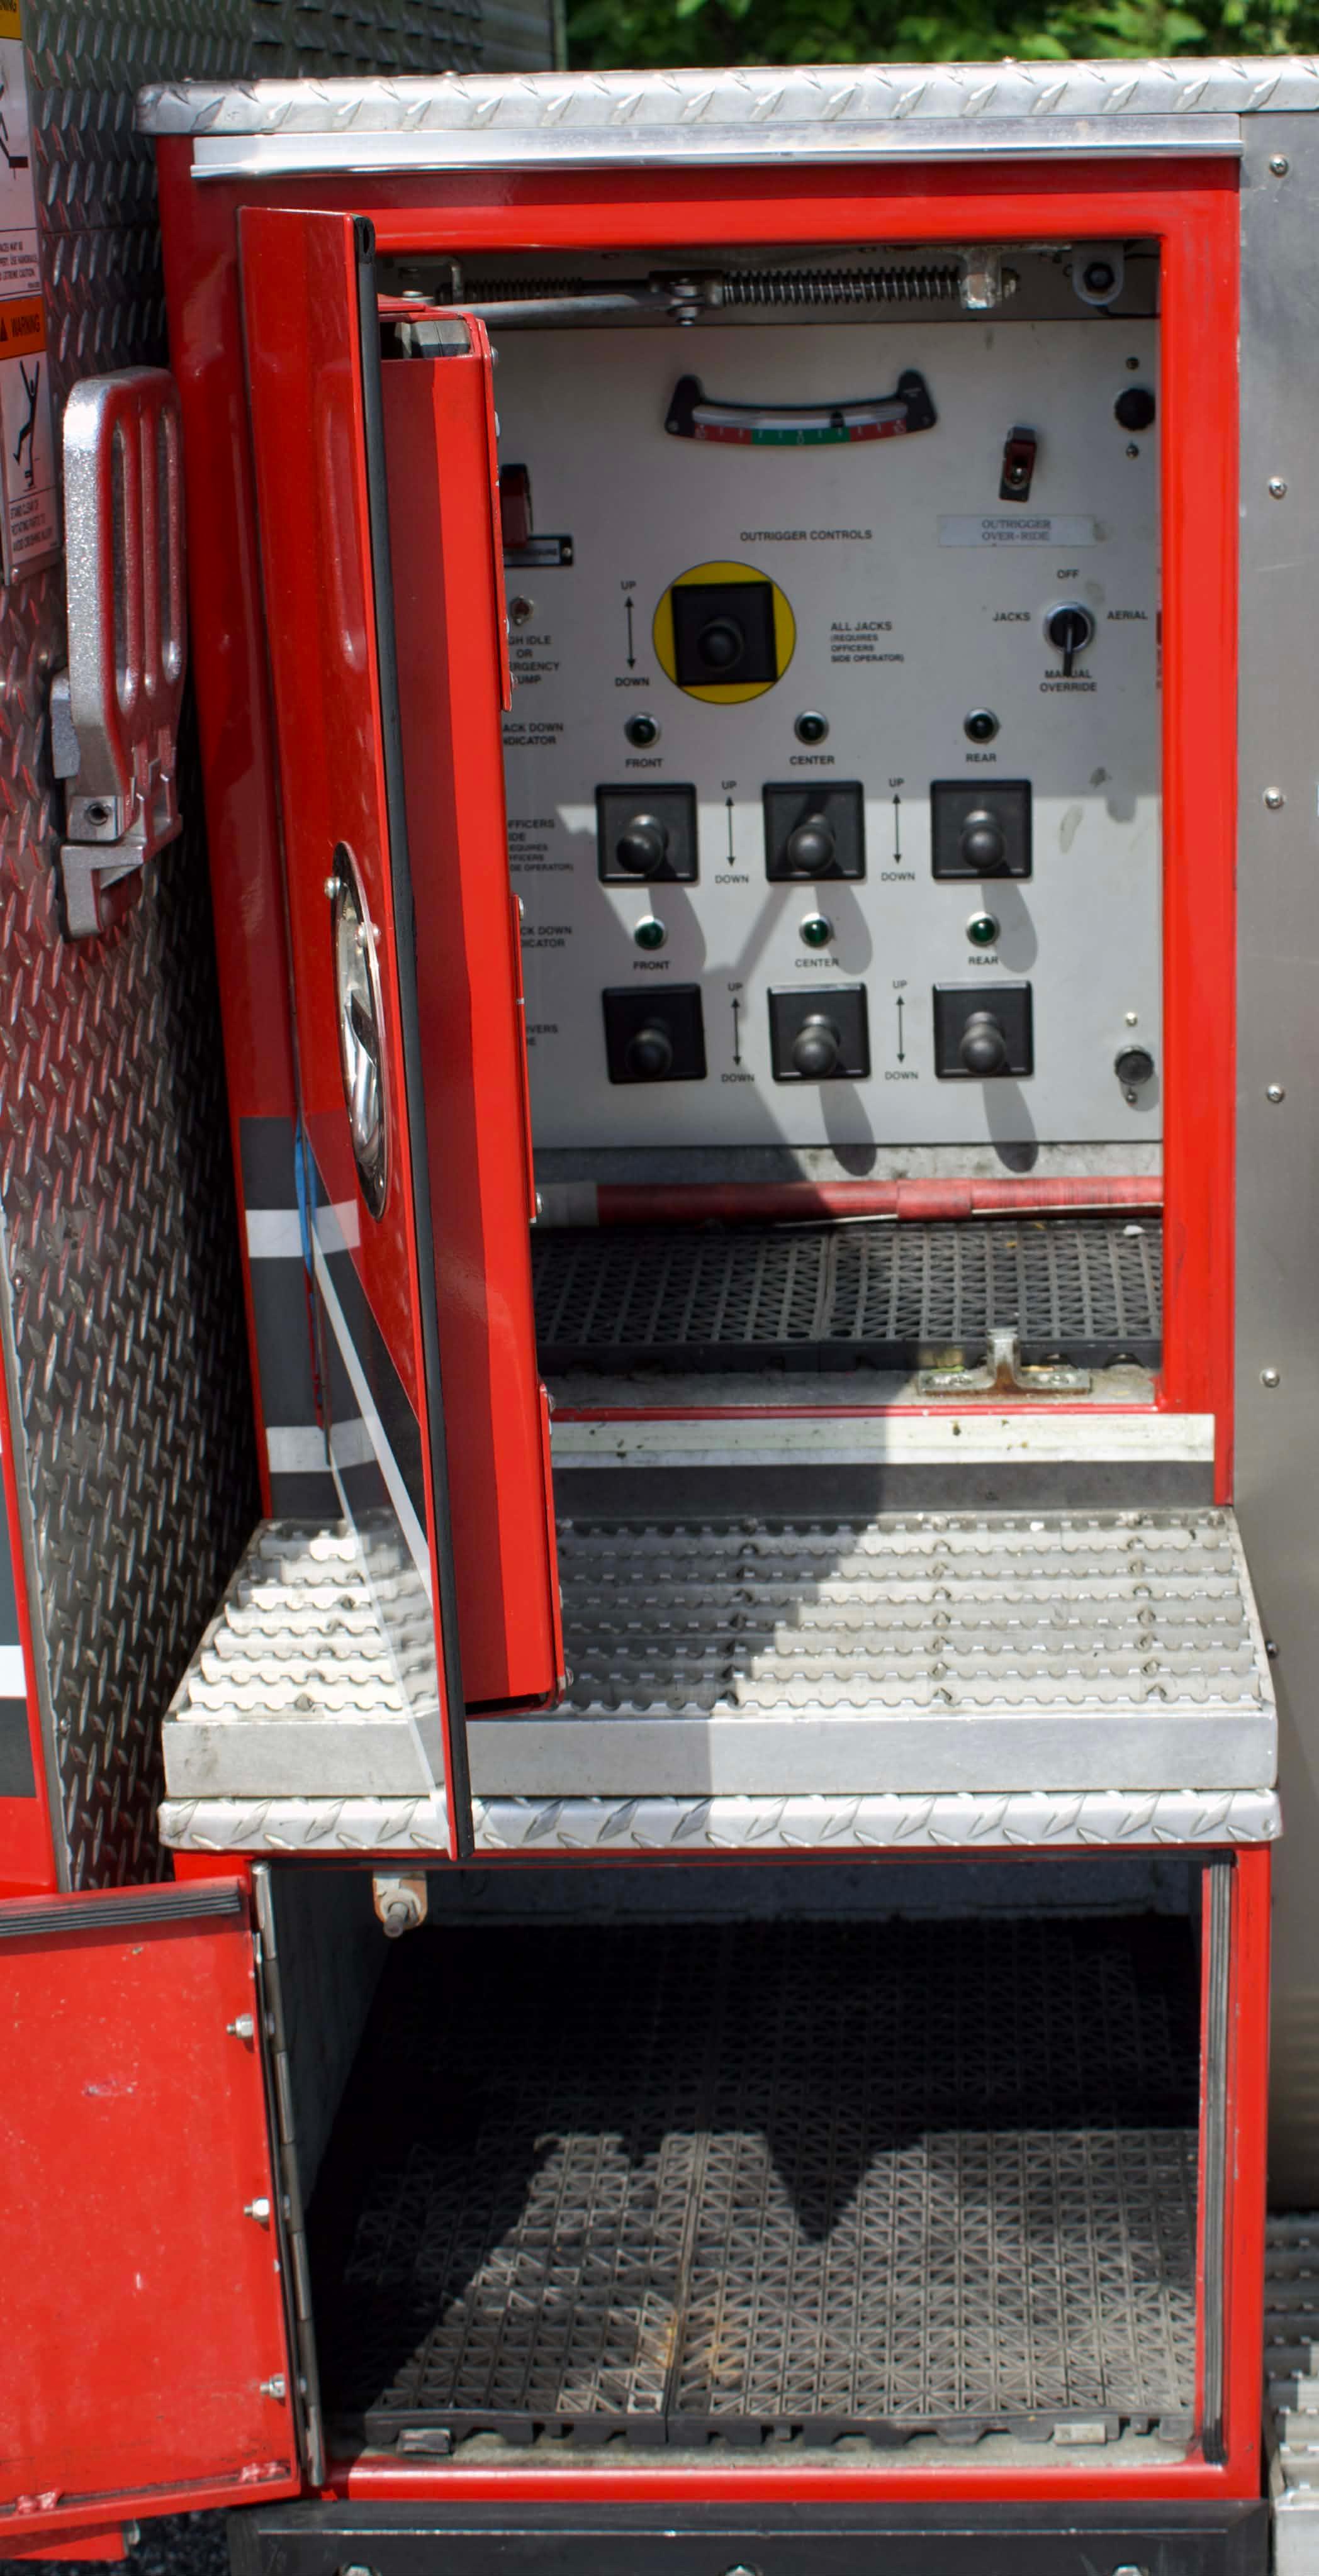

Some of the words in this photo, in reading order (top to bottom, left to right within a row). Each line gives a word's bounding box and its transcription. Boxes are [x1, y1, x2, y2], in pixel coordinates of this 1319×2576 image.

[11, 314, 40, 337] WARNING
[981, 519, 1051, 529] OUTRIGGER
[740, 531, 807, 541] OUTRIGGER
[810, 530, 872, 540] CONTROLS
[981, 532, 1050, 540] OVER-RIDE
[1057, 570, 1079, 579] OFF
[620, 581, 636, 590] UP
[993, 613, 1030, 622] JACKS
[1107, 611, 1148, 620] AERIAL
[831, 621, 851, 631] ALL
[855, 621, 892, 631] JACKS
[508, 635, 524, 645] GH
[526, 635, 551, 645] IDLE
[517, 649, 533, 659] OR
[518, 674, 541, 684] UMP
[615, 677, 649, 687] DOWN
[1040, 682, 1097, 693] OVERRIDE
[503, 723, 525, 732] ACK
[529, 722, 564, 733] DOWN
[790, 756, 834, 766] CENTER
[966, 753, 997, 762] REAR
[626, 758, 663, 768] FRONT
[722, 781, 736, 790] UP
[889, 778, 904, 788] UP
[507, 819, 555, 829] FFICERS
[508, 832, 526, 841] IDE
[715, 875, 749, 884] DOWN
[881, 873, 915, 881] DOWN
[537, 925, 573, 935] DOWN
[795, 958, 839, 967] CENTER
[968, 956, 999, 965] REAR
[633, 961, 670, 971] FRONT
[727, 982, 743, 992] UP
[892, 979, 907, 989] UP
[721, 1073, 755, 1083] DOWN
[885, 1071, 919, 1080] DOWN
